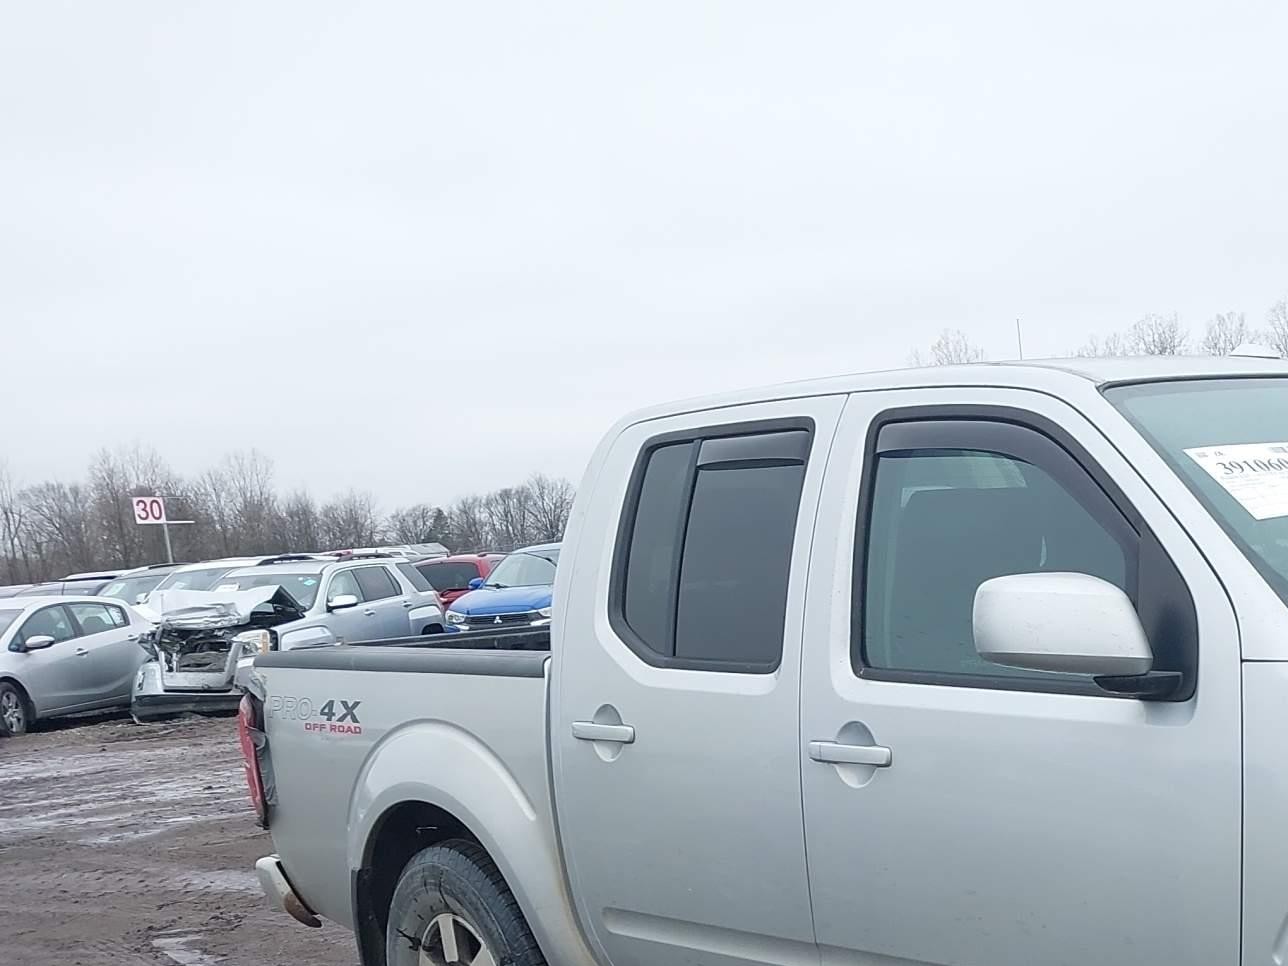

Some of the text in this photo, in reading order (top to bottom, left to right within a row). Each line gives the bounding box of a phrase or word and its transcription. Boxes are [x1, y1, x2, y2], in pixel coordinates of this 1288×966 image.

[135, 499, 163, 521] 30
[304, 722, 363, 735] OFF ROAD
